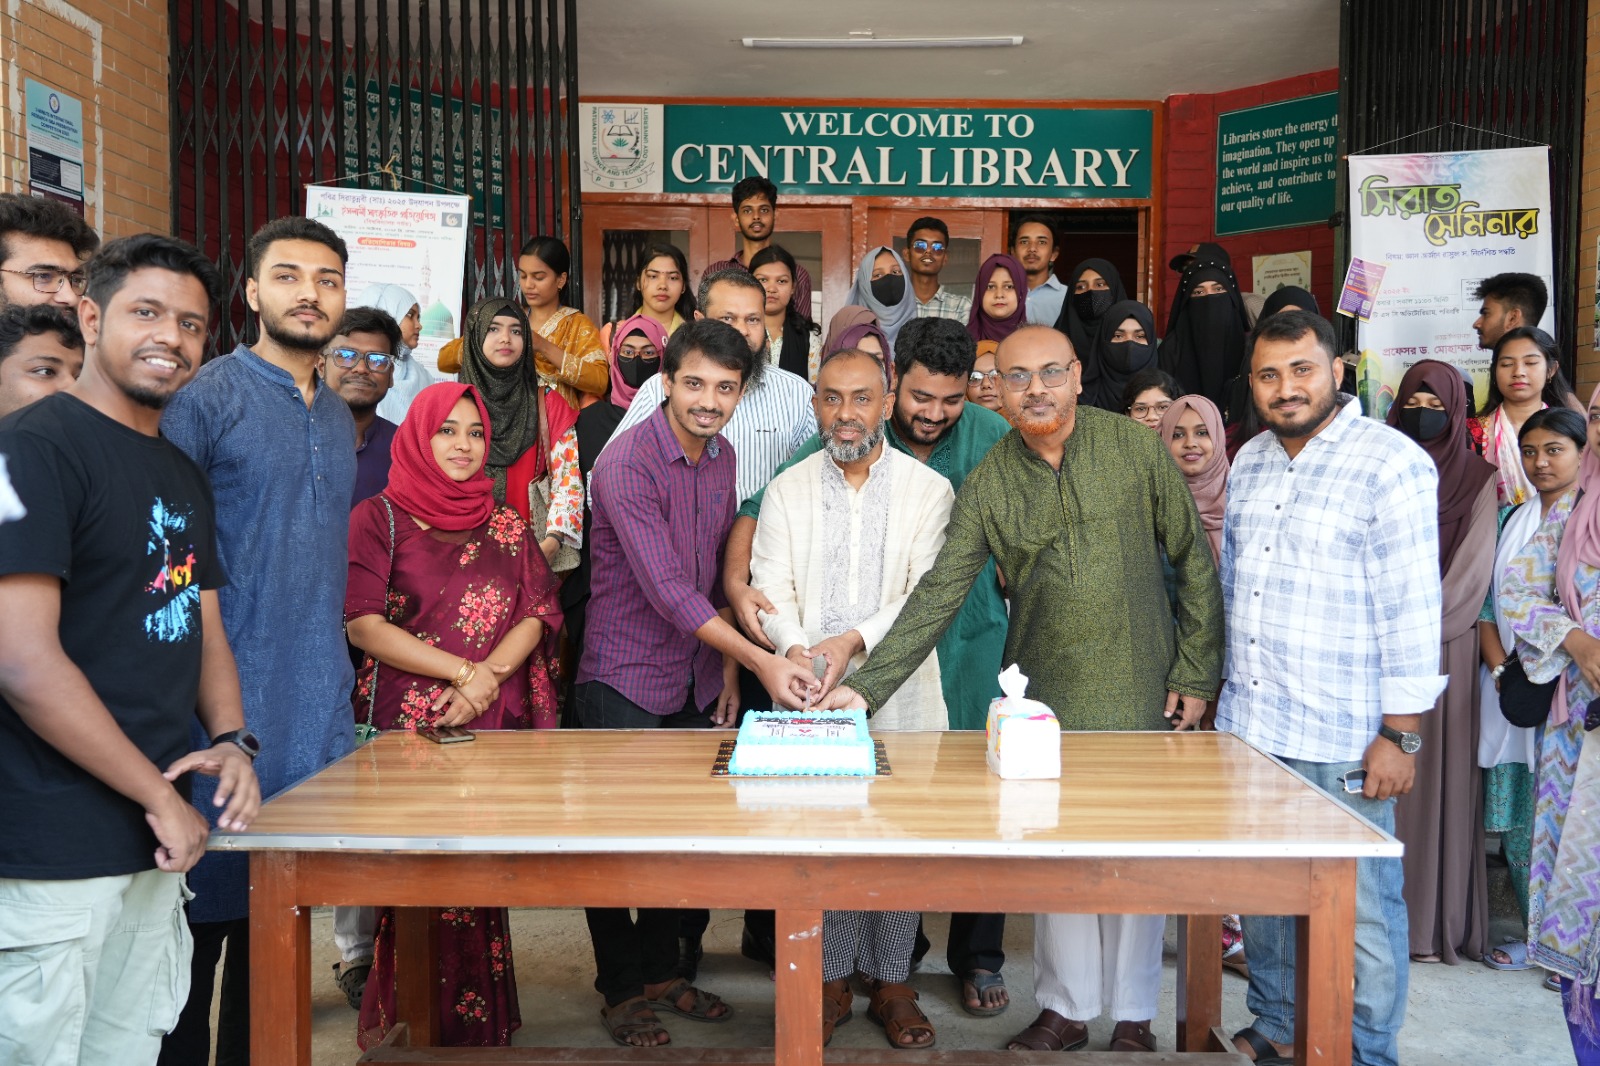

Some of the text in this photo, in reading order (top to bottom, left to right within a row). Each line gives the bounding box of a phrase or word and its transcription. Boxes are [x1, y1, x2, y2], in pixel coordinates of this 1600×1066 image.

[780, 112, 1034, 138] WELCOME TO
[1223, 129, 1260, 146] Libraries
[1262, 127, 1282, 139] store
[1285, 122, 1298, 134] the
[1300, 119, 1329, 132] energy
[592, 147, 606, 171] SCIENCE
[622, 146, 649, 176] TECHNOLOGY
[1222, 136, 1334, 163] imagination. They open up
[671, 144, 1140, 187] CENTRAL LIBRARY
[1222, 152, 1332, 178] the world and inspire us to
[1222, 170, 1336, 196] achieve, and contribute to
[320, 192, 336, 200] পবিত্র
[388, 198, 406, 206] ২০২৫
[1221, 192, 1293, 213] our quality of life.
[1358, 175, 1461, 220] সিরাত
[367, 207, 398, 220] সাংস্কৃতিক
[400, 208, 436, 223] প্রতিযোগিতা
[1424, 201, 1540, 246] সেমিনার
[1382, 346, 1416, 356] প্রফেসর
[1418, 346, 1430, 354] ড.
[1434, 344, 1472, 354] মোহাম্মদ
